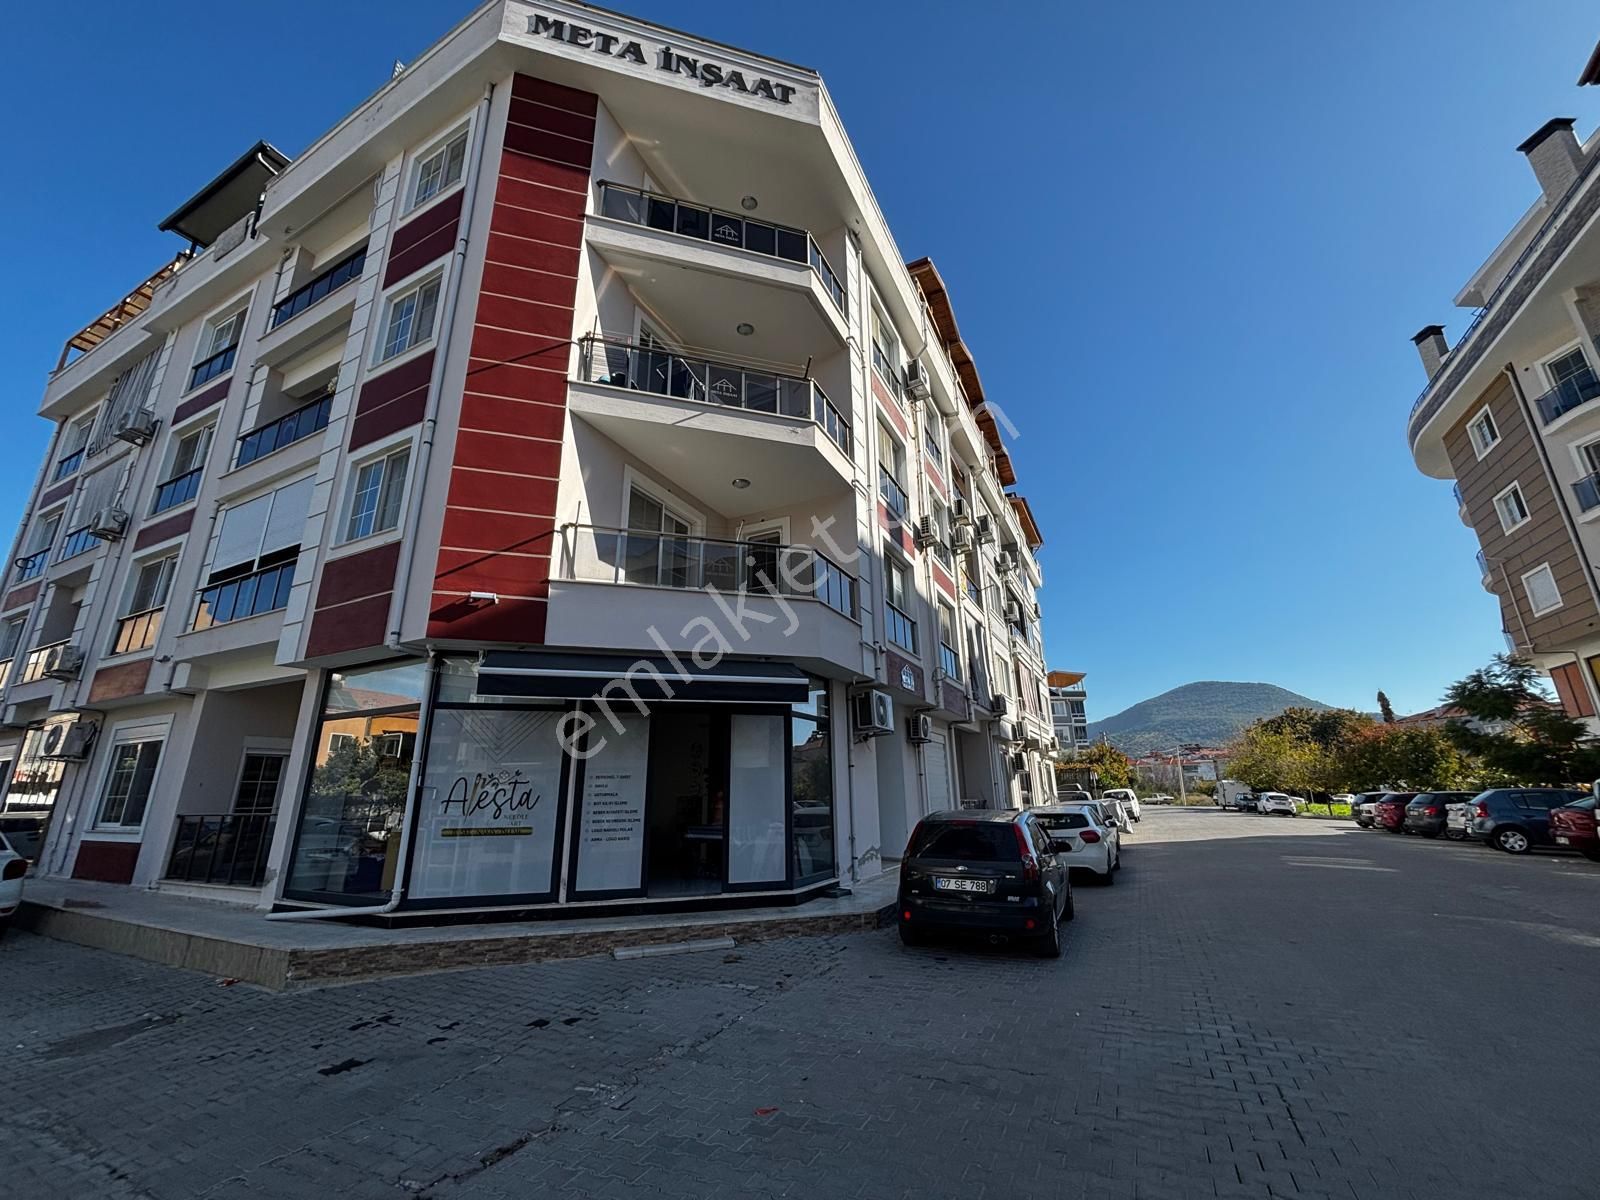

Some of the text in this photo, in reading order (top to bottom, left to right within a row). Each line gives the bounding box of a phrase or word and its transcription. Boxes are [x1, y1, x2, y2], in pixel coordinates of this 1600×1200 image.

[528, 14, 796, 104] META İNŞAAT
[941, 880, 986, 891] 07 SE 788
